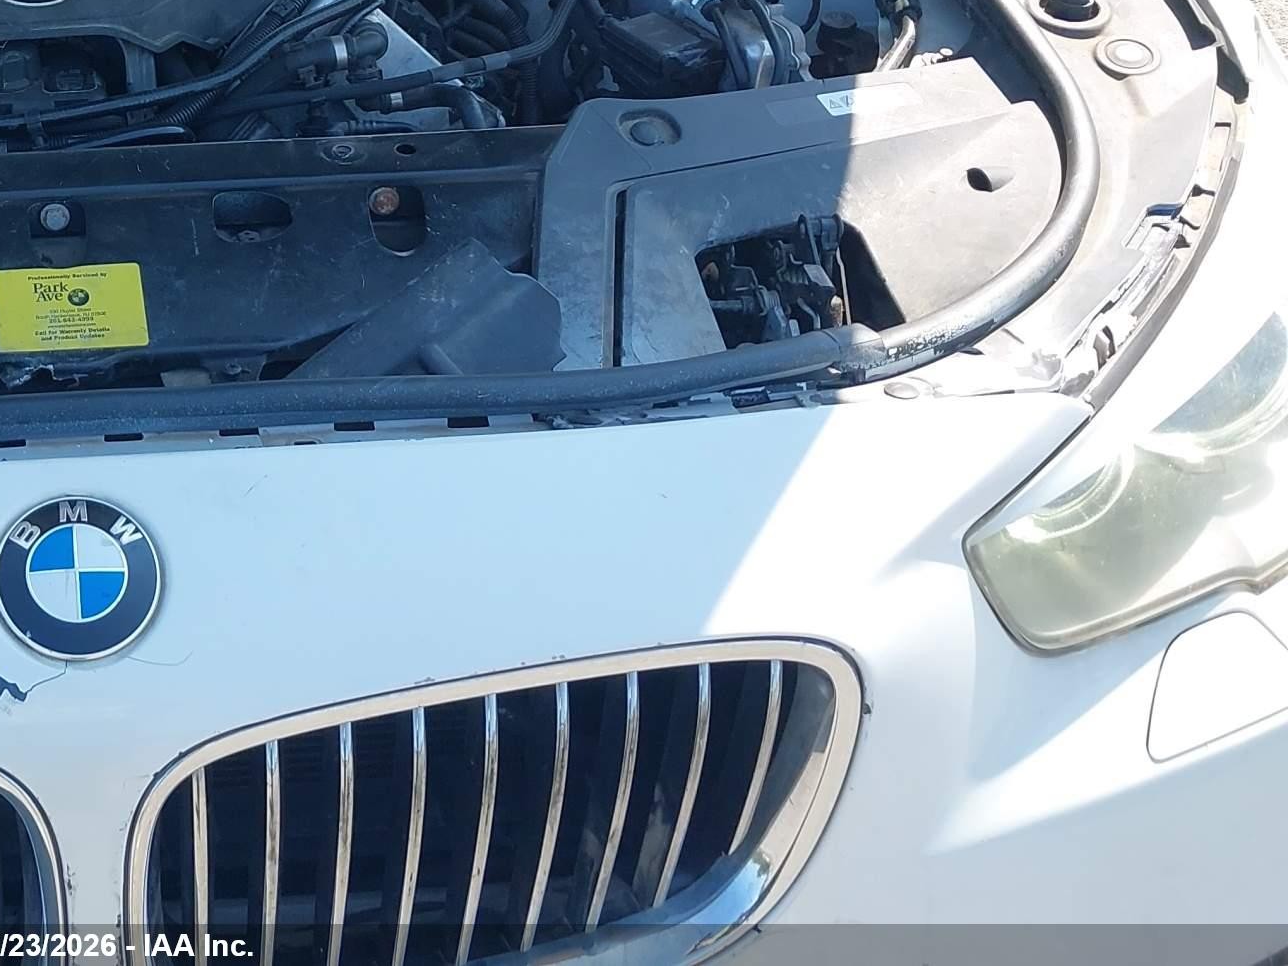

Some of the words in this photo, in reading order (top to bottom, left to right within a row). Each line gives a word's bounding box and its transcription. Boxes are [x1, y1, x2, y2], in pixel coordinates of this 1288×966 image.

[33, 281, 69, 293] Park
[36, 291, 63, 302] Ave
[9, 500, 144, 550] BMW
